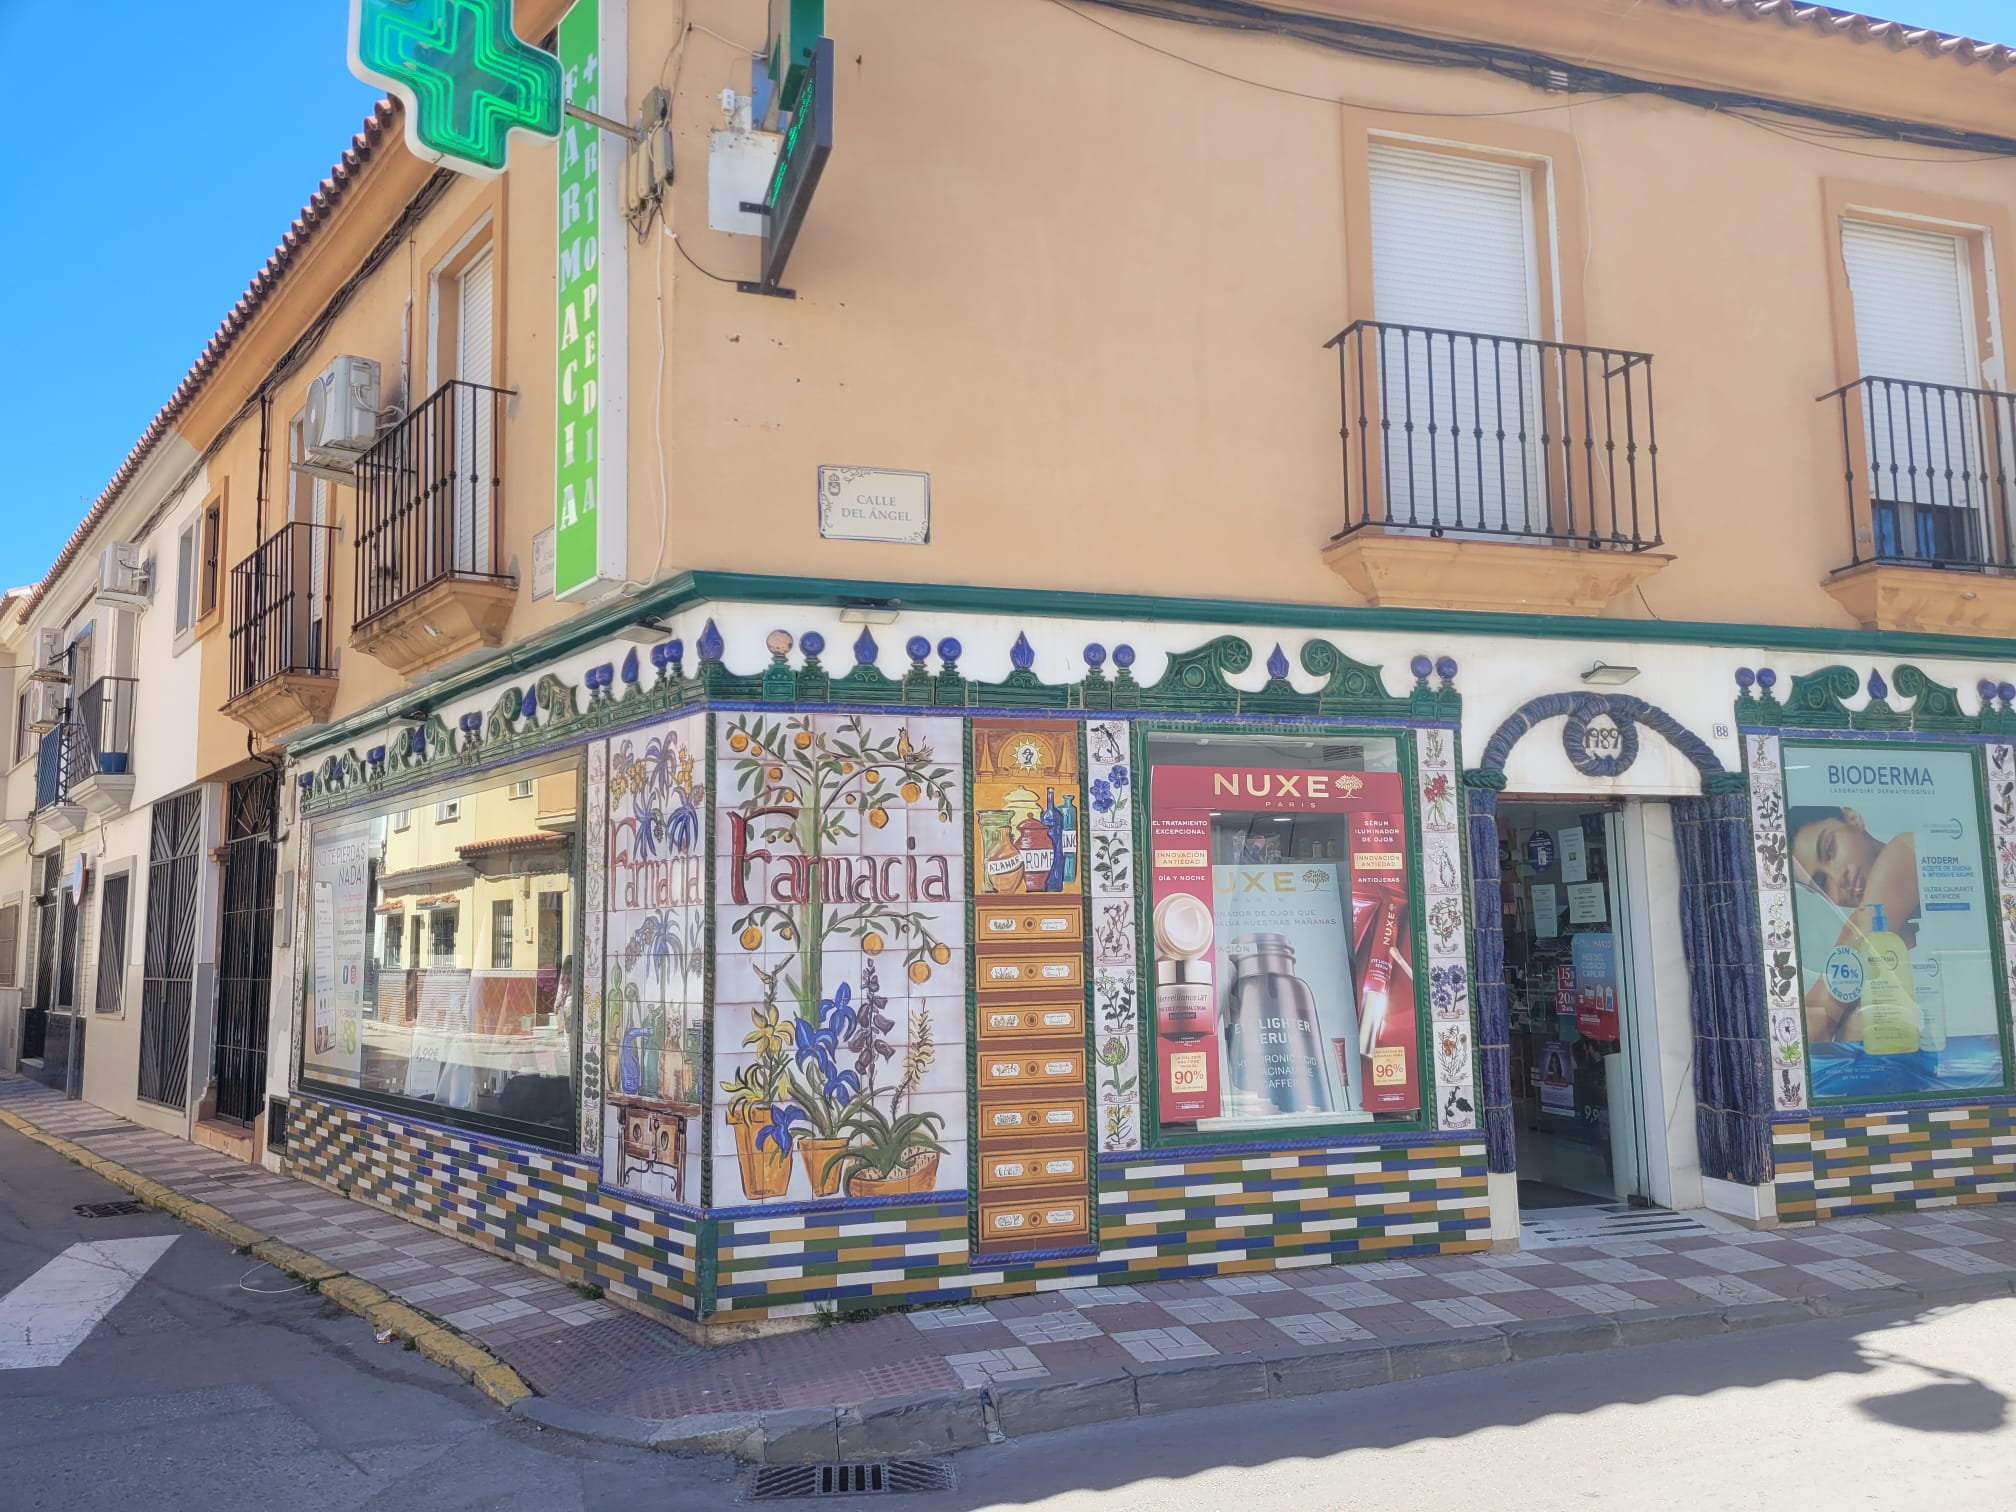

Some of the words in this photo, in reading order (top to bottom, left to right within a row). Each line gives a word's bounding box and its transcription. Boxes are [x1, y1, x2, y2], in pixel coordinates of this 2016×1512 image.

[559, 64, 582, 531] FARMACIA
[856, 494, 897, 507] CALLE
[841, 507, 866, 519] DEL
[868, 507, 912, 521] ÁNGEL
[1585, 727, 1620, 749] 1989
[1715, 725, 1729, 737] 88
[1827, 765, 1934, 786] BIODERMA
[1213, 773, 1330, 798] NUXE
[1265, 801, 1317, 809] PARIS
[336, 842, 366, 865] PIERDAS
[727, 805, 952, 905] Farmacia
[1921, 856, 1959, 865] ATODERM
[611, 817, 703, 911] Farmacia
[988, 854, 1021, 872] AZAHAR
[338, 863, 366, 888] NADA!
[1213, 871, 1297, 893] UXE
[1382, 911, 1397, 946] NUXE
[1214, 945, 1250, 953] ACIÓN
[1837, 947, 1850, 955] SIN
[1831, 964, 1859, 980] 76%
[1831, 986, 1862, 1001] BROTES
[1259, 1017, 1312, 1033] LIGHER
[1254, 1032, 1293, 1045] ERU
[1174, 1070, 1204, 1085] 90%
[1376, 1063, 1404, 1078] 96%
